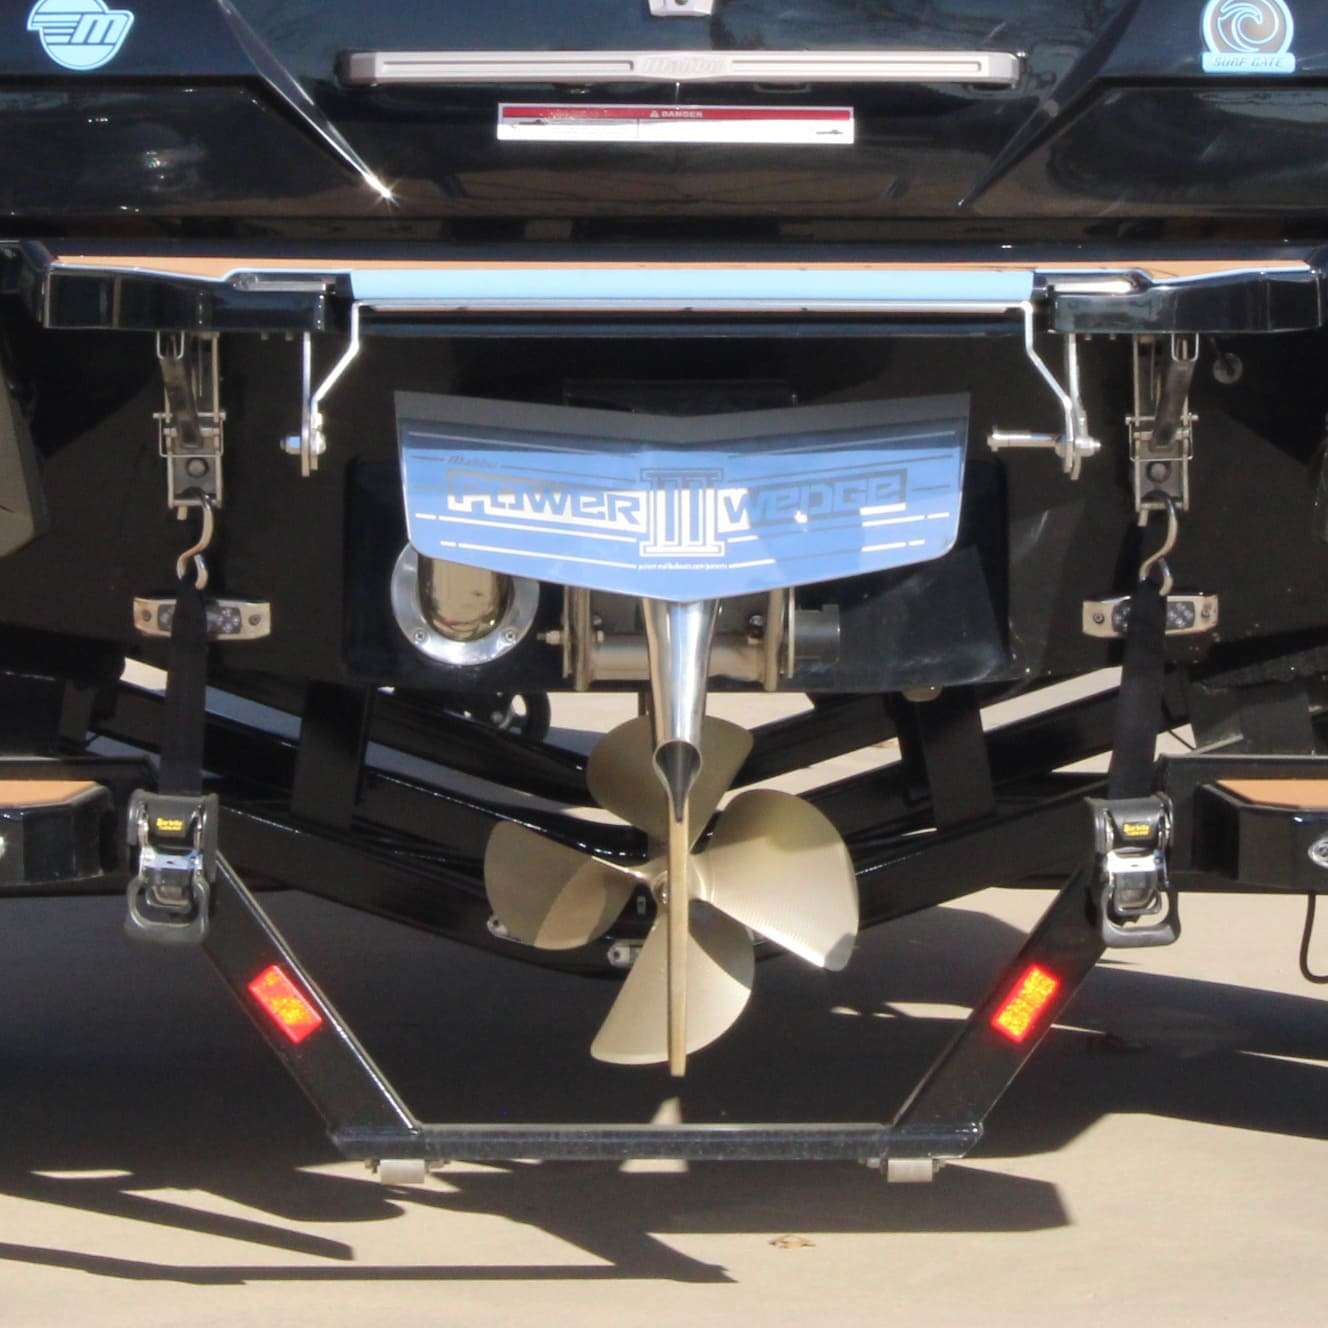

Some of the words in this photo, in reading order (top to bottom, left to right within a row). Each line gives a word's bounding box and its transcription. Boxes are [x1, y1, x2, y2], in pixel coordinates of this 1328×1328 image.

[1212, 57, 1246, 68] SURF
[1251, 57, 1282, 68] GATE
[661, 109, 704, 119] DANGER
[639, 467, 725, 557] III
